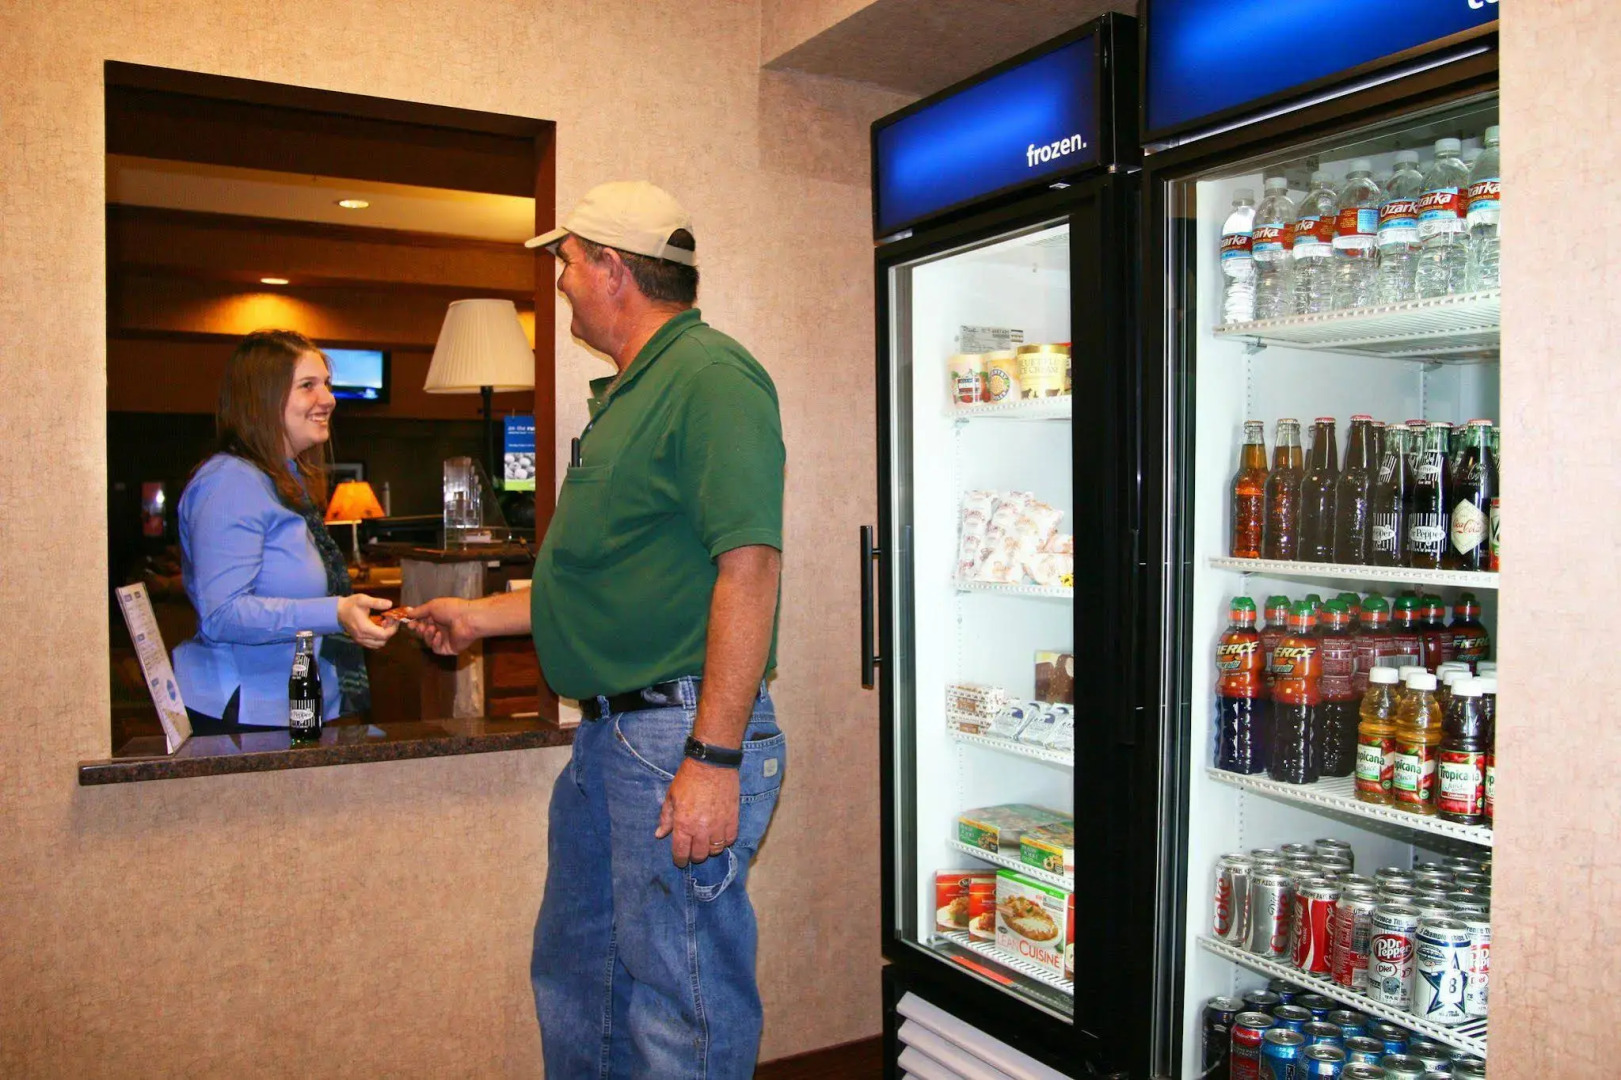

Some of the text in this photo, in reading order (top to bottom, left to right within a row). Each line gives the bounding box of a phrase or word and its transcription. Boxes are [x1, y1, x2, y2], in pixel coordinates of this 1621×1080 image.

[1027, 134, 1087, 167] frozen.
[1468, 182, 1499, 196] zarka
[1419, 192, 1452, 206] zarka
[1380, 202, 1418, 217] Ozark
[1252, 228, 1279, 240] zarka
[1221, 235, 1247, 248] zarka
[1217, 641, 1259, 655] IERCE
[1274, 647, 1316, 658] ERCE
[1358, 751, 1385, 765] picana
[1395, 759, 1421, 774] picana
[1378, 939, 1412, 959] Pepper
[1386, 938, 1403, 949] Dr
[1019, 940, 1060, 968] CUISINE
